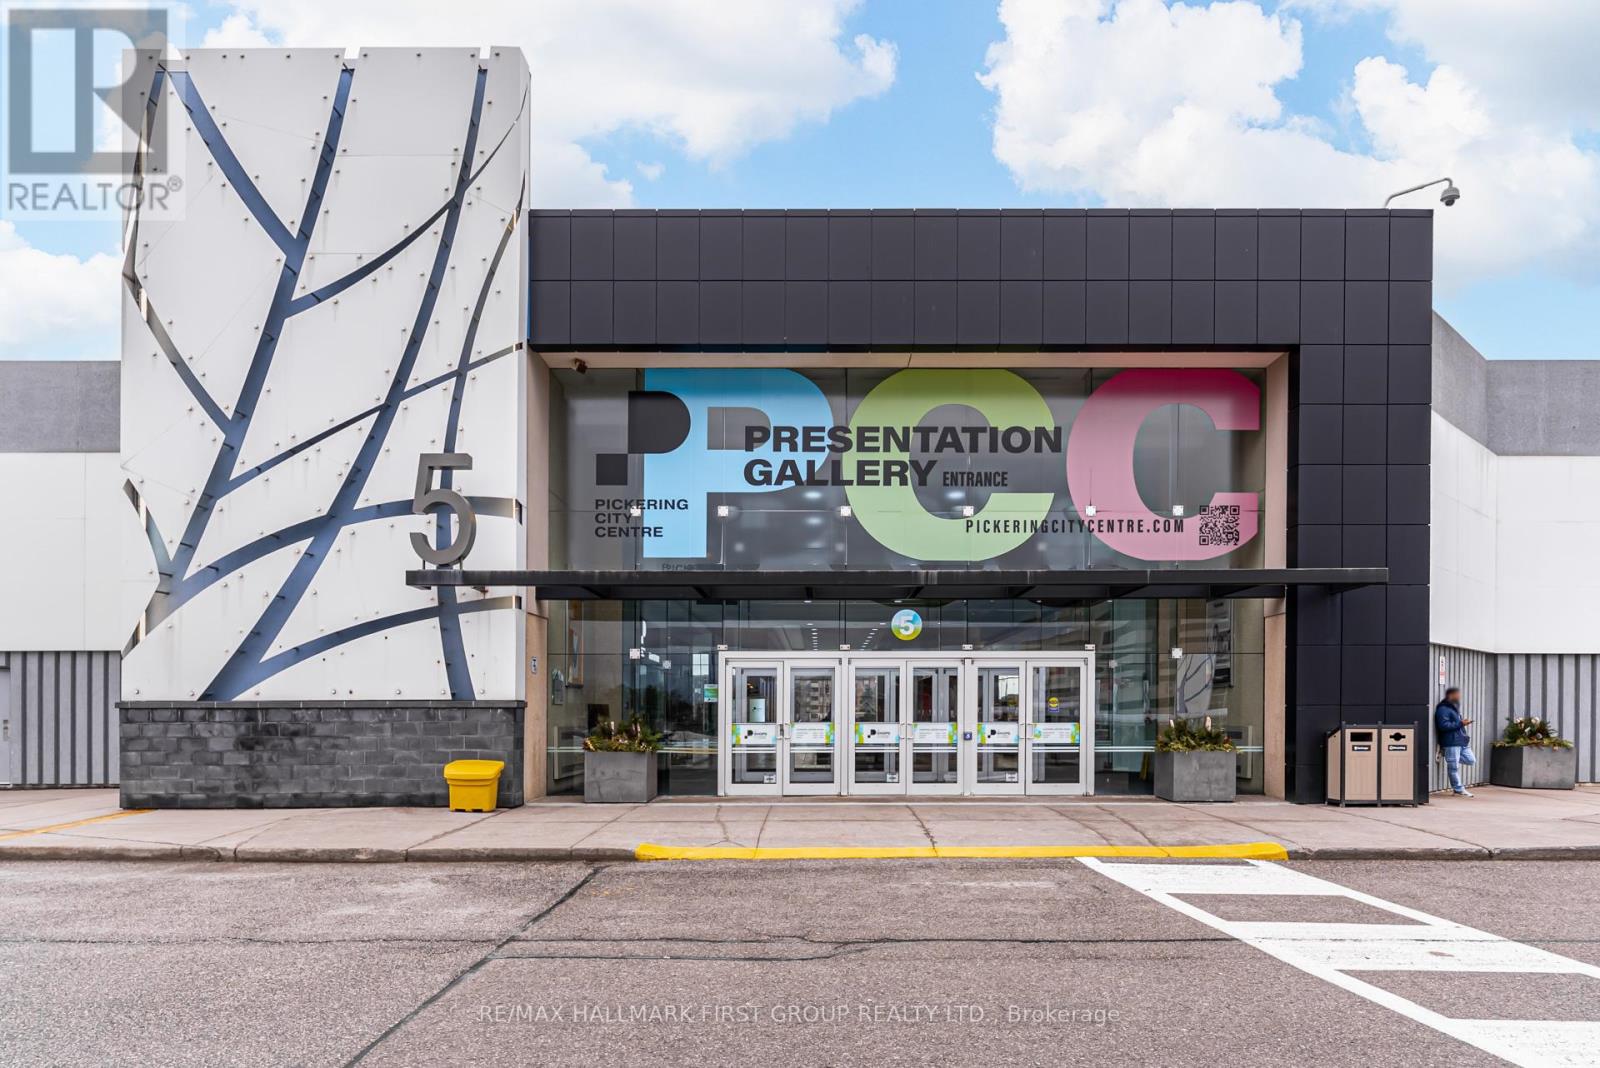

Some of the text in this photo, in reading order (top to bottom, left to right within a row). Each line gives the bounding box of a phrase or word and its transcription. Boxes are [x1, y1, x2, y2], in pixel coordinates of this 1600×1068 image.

[744, 425, 1062, 454] PRESENTATION
[743, 459, 1008, 487] GALLERY ENTRANCE
[409, 453, 476, 566] 5
[595, 499, 689, 510] PICKERING
[594, 512, 632, 524] CITY
[966, 519, 1184, 533] PICKERINGCITYCENTRE.COM
[594, 526, 664, 538] CENTRE
[897, 615, 915, 635] 5
